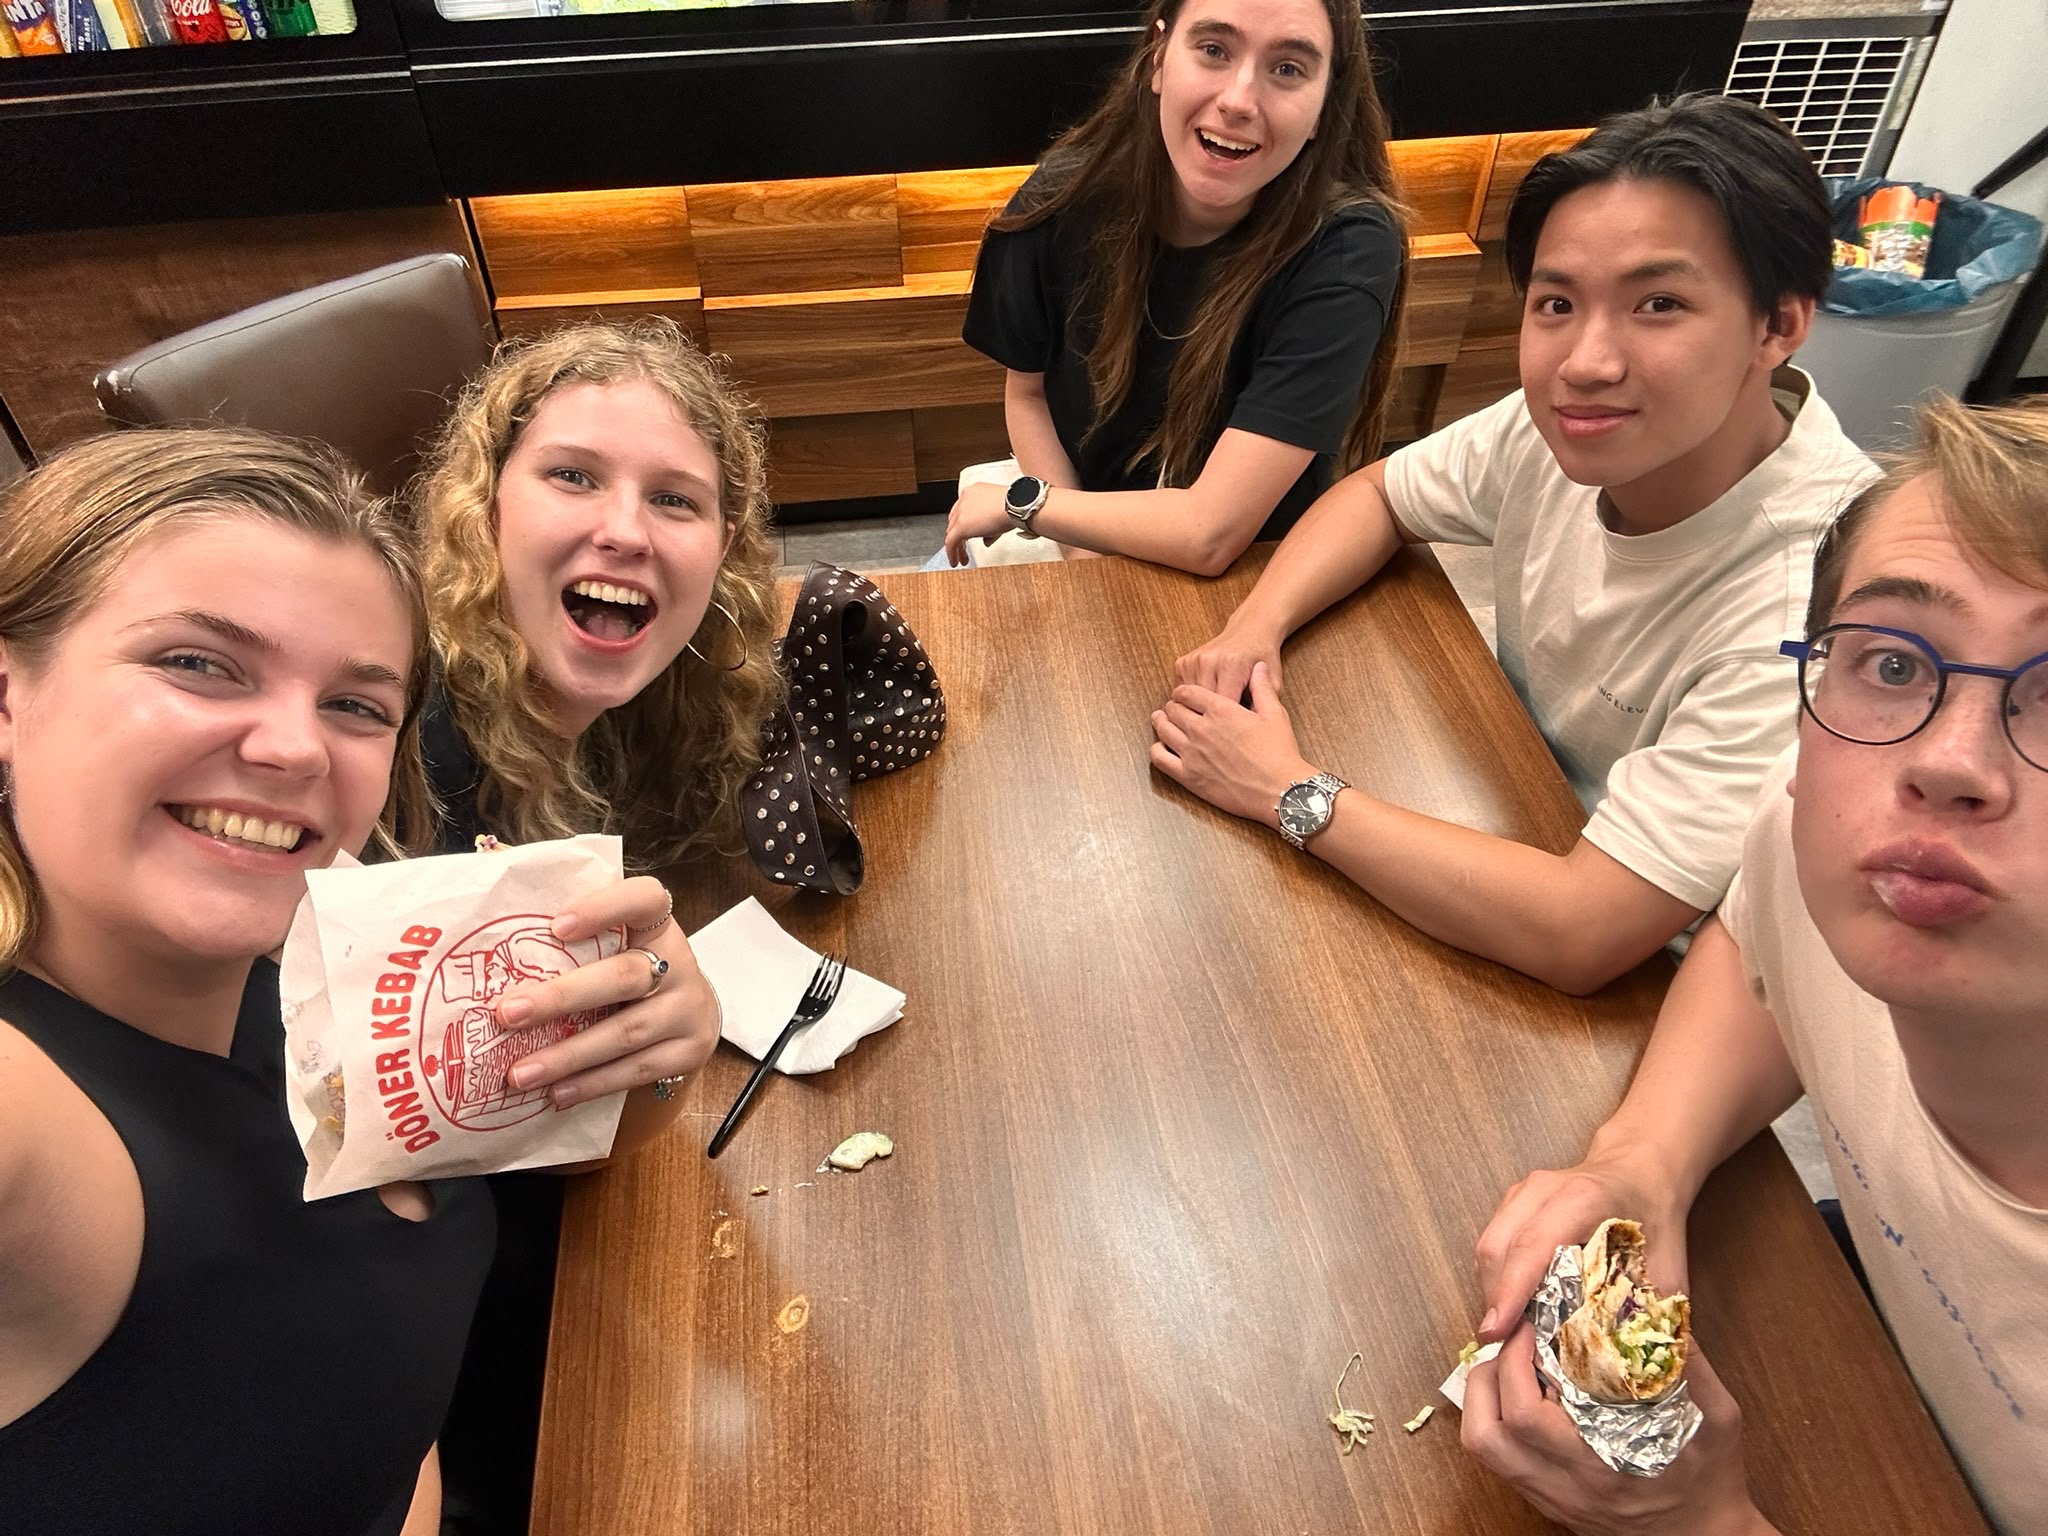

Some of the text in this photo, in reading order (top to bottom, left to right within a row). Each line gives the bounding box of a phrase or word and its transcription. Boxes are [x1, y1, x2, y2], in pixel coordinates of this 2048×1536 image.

[83, 17, 91, 43] GRAPE
[371, 924, 444, 1154] DÖNER KEBAB
